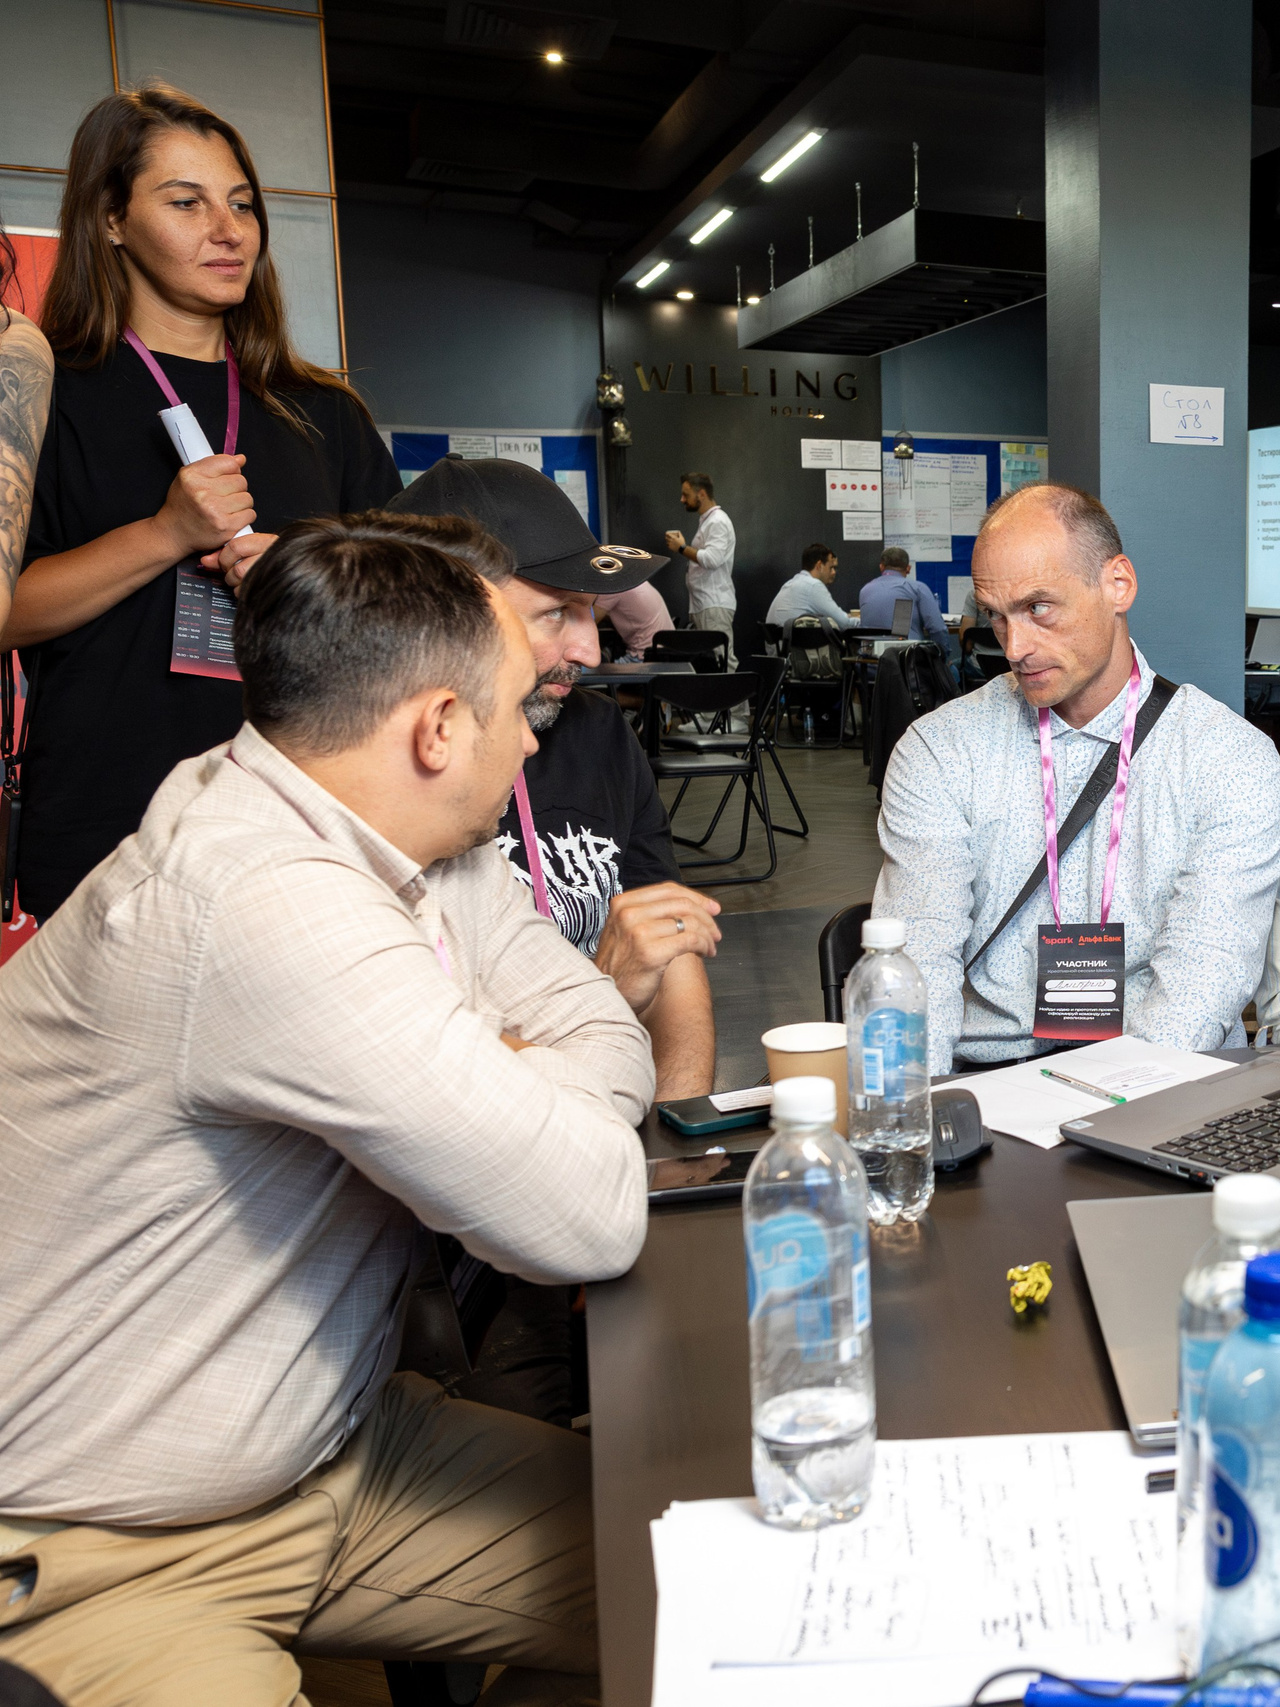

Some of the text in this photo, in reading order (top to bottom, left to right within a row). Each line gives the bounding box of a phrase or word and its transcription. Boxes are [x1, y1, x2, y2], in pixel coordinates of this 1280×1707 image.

[633, 361, 858, 401] WILLING
[1043, 936, 1074, 945] spark
[1078, 934, 1122, 945] Альфа Банк
[1055, 960, 1108, 968] УЧАСТНИК
